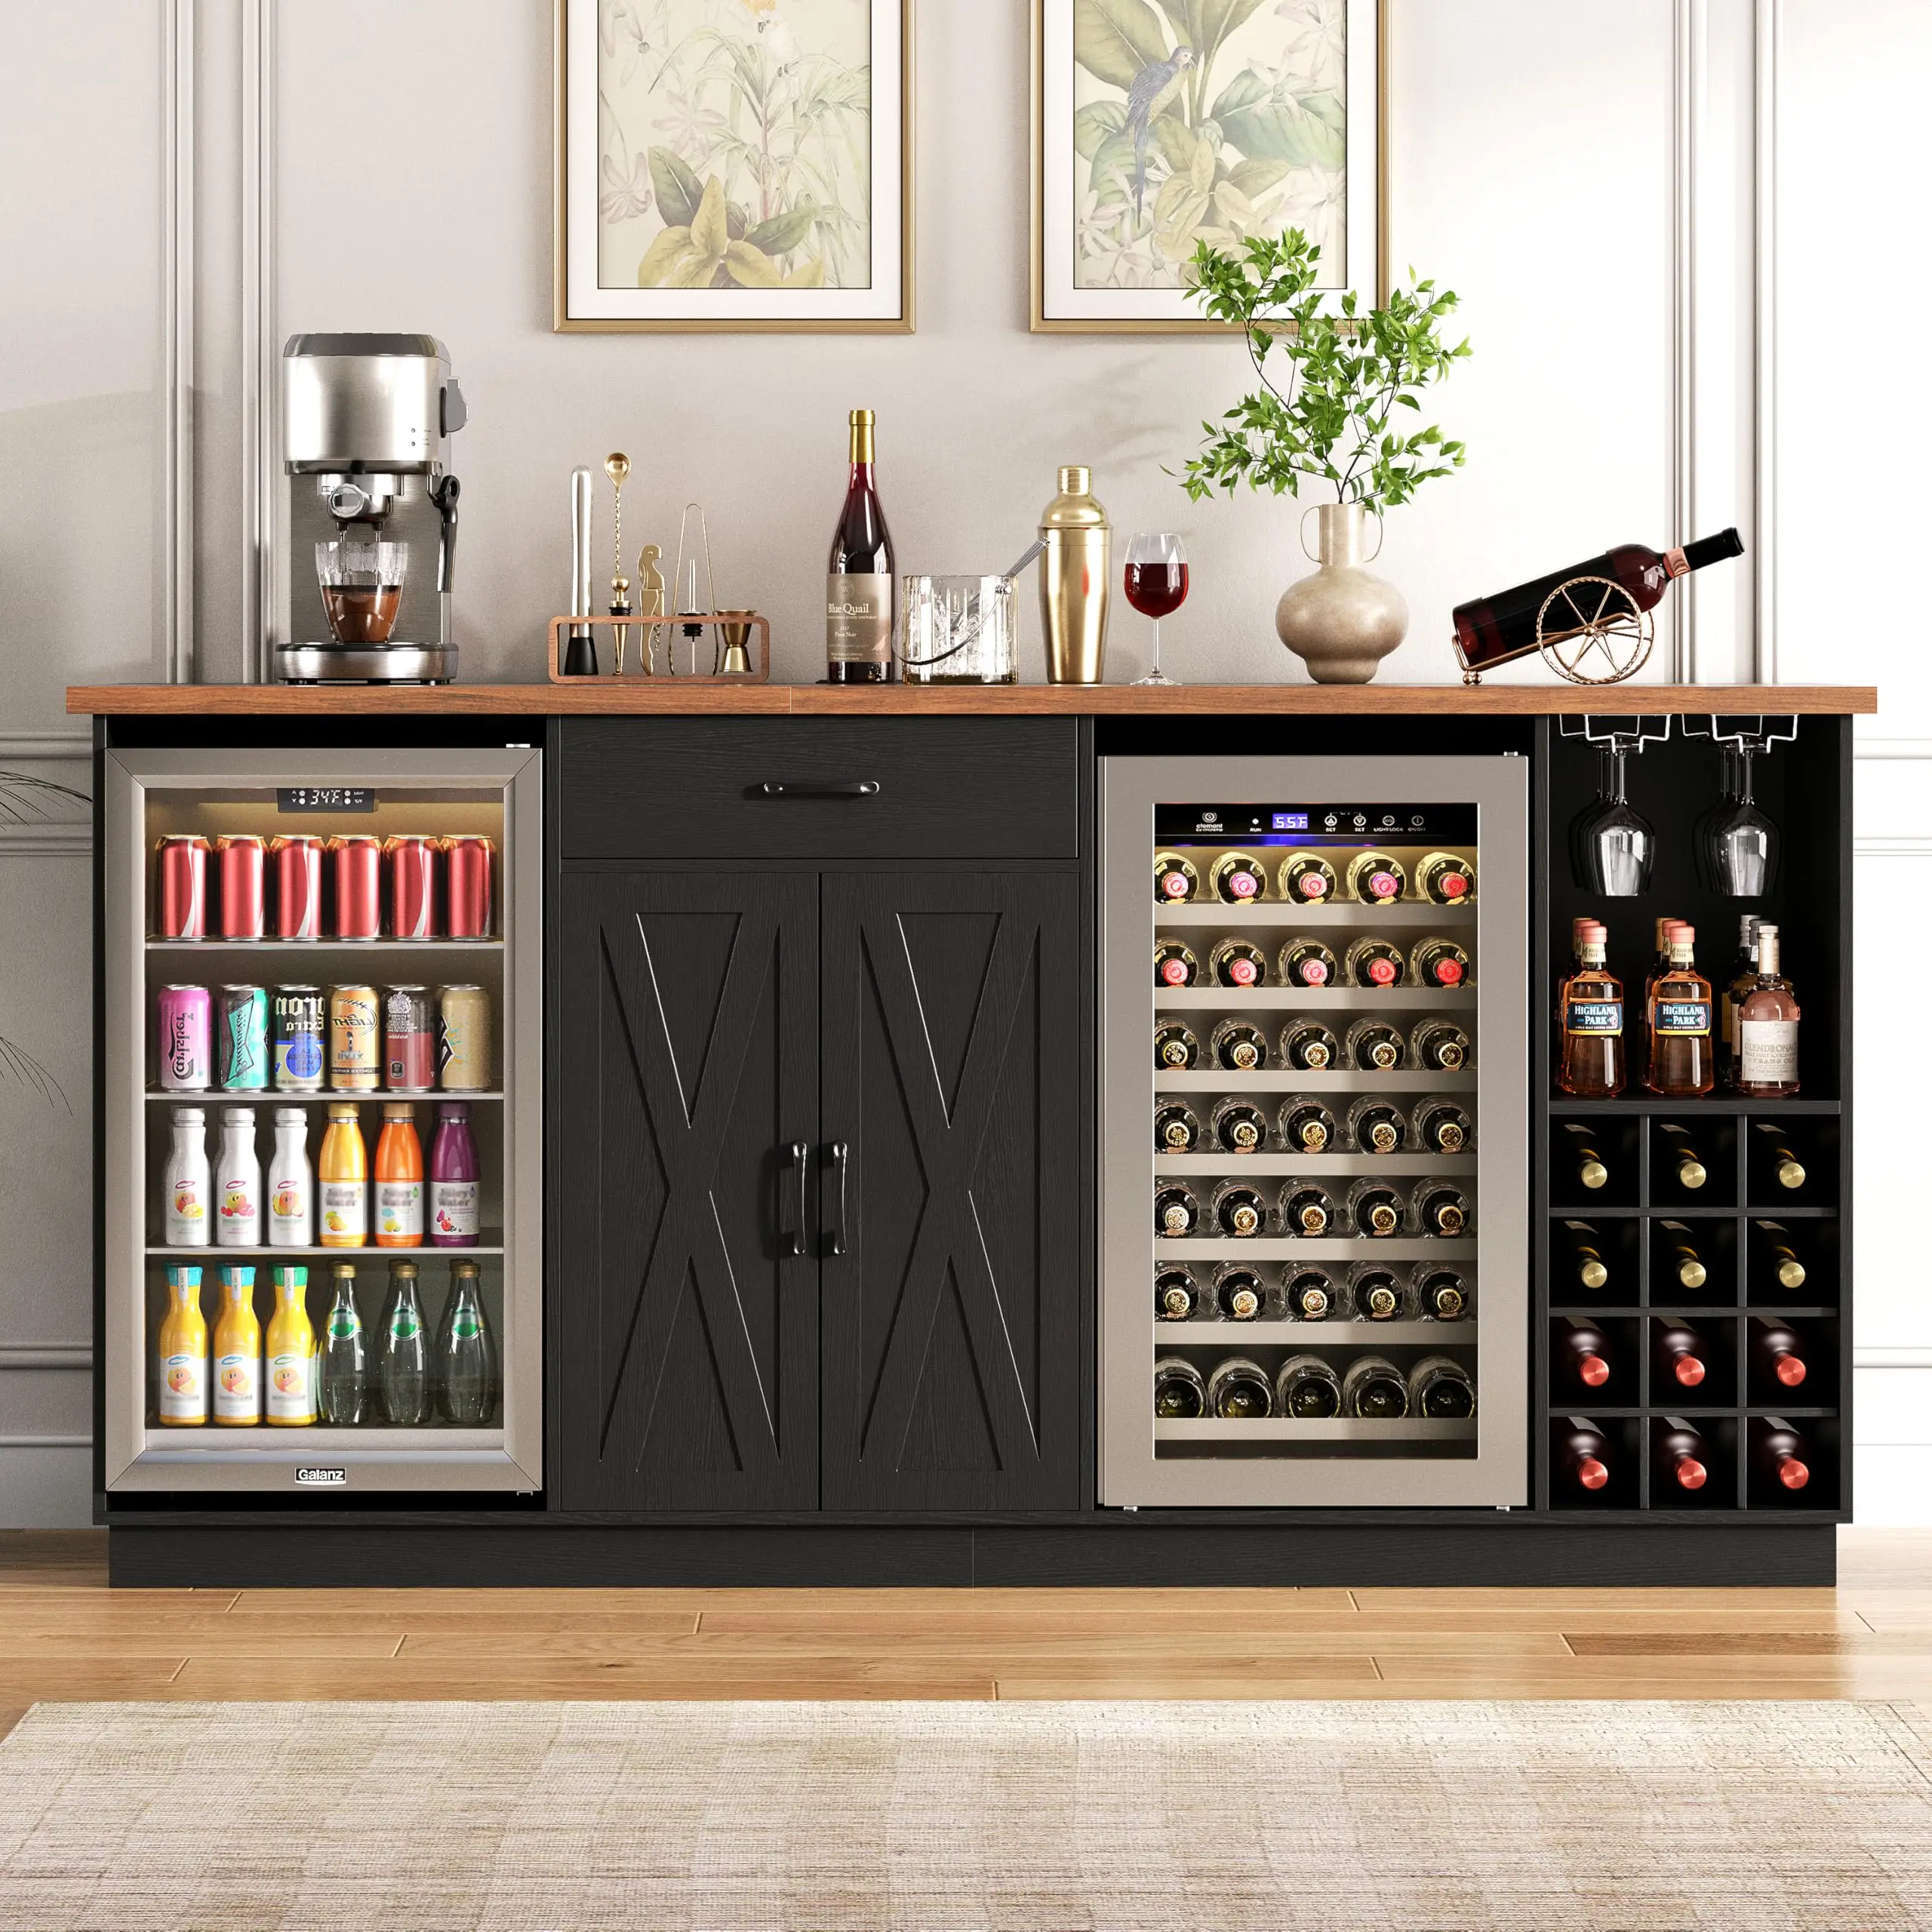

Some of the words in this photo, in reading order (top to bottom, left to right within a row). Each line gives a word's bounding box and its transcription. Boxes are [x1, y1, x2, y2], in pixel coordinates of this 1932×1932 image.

[828, 604, 842, 613] Blue
[843, 603, 869, 616] Quail
[1574, 1005, 1617, 1015] HIGHLAND
[1663, 1005, 1705, 1015] HIGHLAND
[1584, 1016, 1607, 1025] PARK
[1672, 1016, 1696, 1025] PARK
[298, 1469, 344, 1481] Galanz
